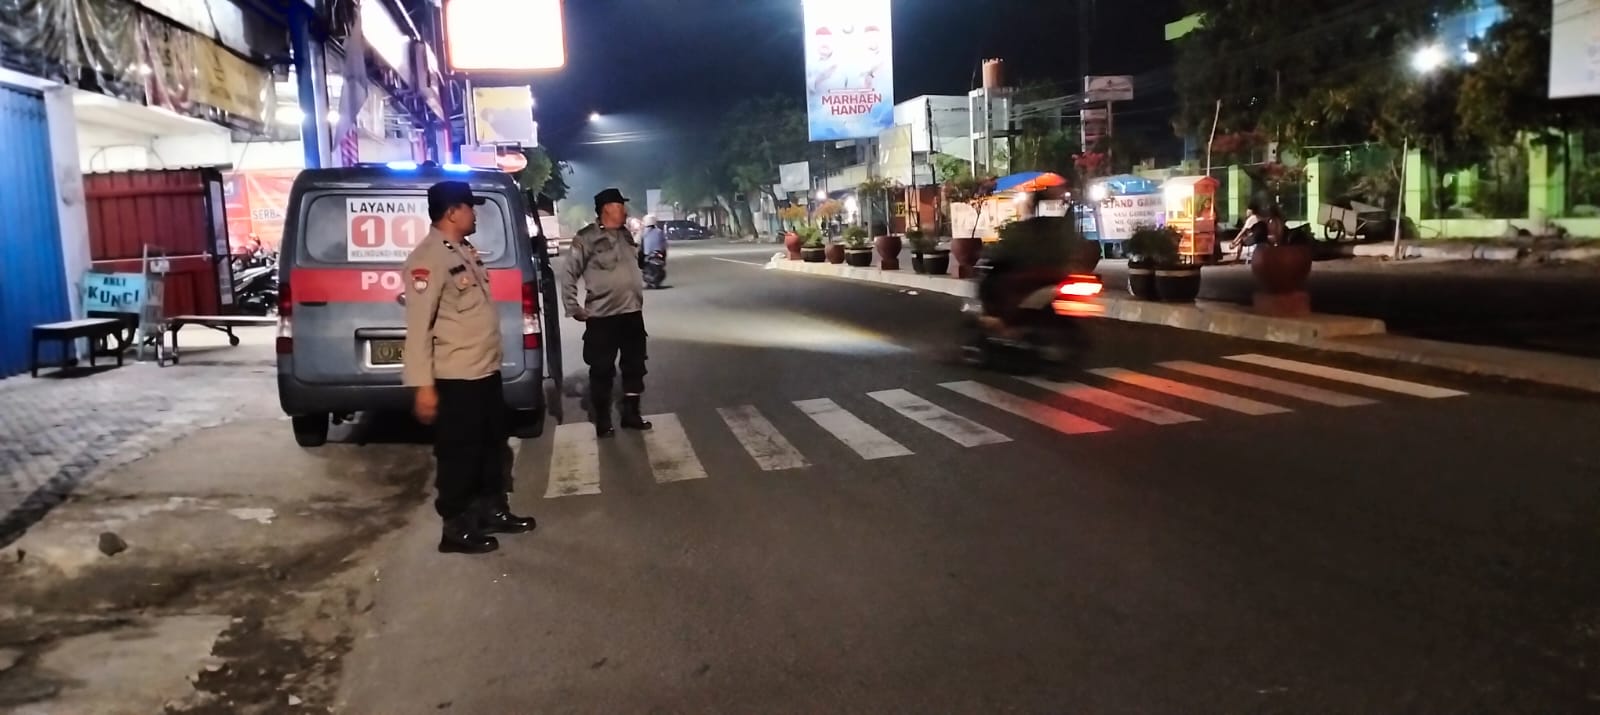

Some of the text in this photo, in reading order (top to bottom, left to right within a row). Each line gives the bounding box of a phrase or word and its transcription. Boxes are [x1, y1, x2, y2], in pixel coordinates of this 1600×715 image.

[821, 93, 883, 105] MARHAEN
[831, 104, 873, 116] HANDY
[350, 202, 416, 213] LAYANAN
[1103, 197, 1133, 209] STAND
[361, 271, 405, 290] PO
[88, 286, 139, 307] KUNCI
